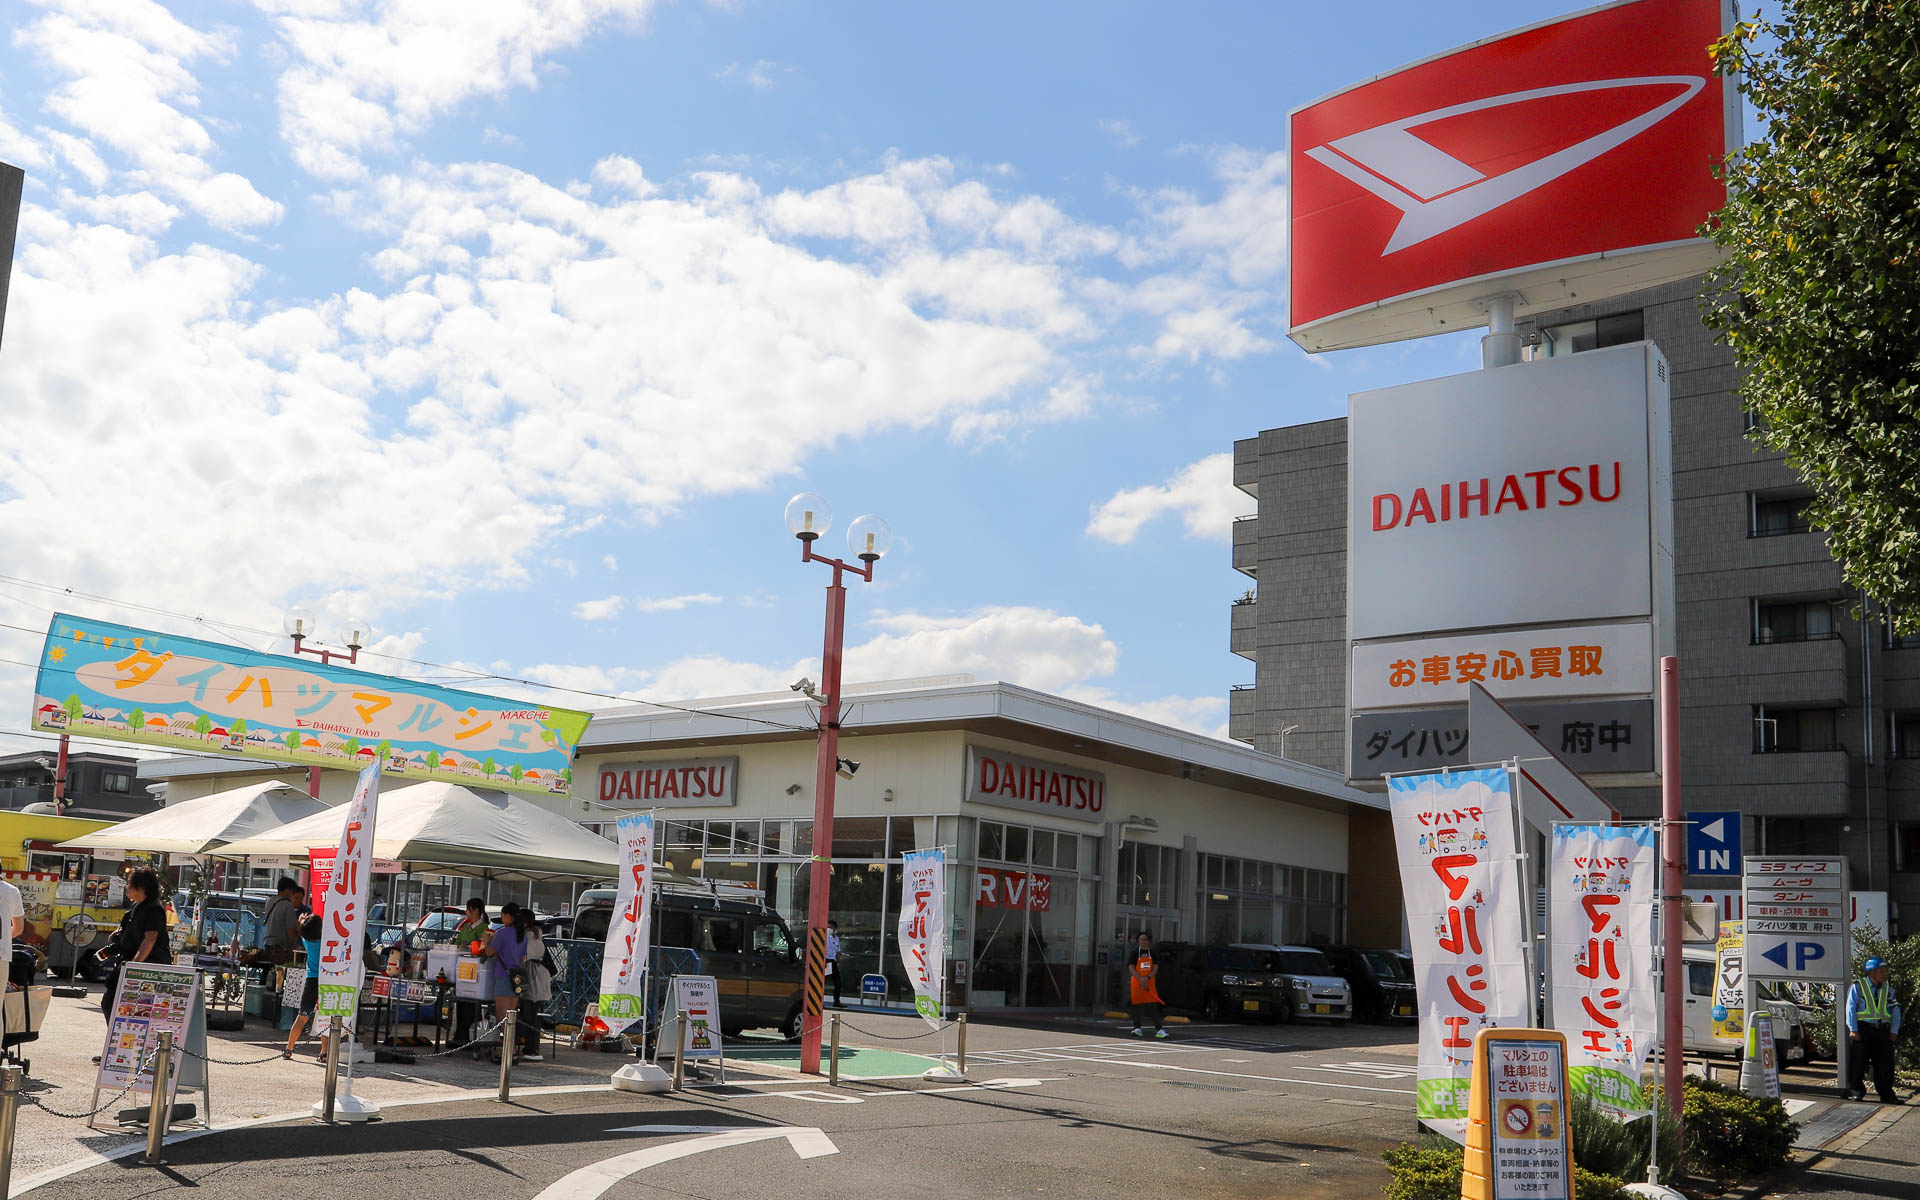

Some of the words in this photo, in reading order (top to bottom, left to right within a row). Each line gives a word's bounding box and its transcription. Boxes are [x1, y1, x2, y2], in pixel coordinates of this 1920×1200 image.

[1372, 461, 1621, 532] DAIHATSU
[1389, 645, 1603, 688] お車安心買取
[113, 647, 534, 751] ダイハツマルシェ
[500, 709, 550, 721] MARCHE
[312, 721, 351, 735] DAIHATSU
[355, 728, 381, 738] TOKYO
[1561, 720, 1632, 755] 府中
[600, 766, 726, 801] DAIHATSU
[980, 756, 1103, 813] DAIHATSU
[1699, 849, 1730, 870] IN
[1772, 877, 1813, 887] ムーヴ
[1773, 892, 1813, 902] タント
[1759, 907, 1829, 916] 車検・点検・整備
[1756, 922, 1808, 931] ダイハツ東京
[1813, 922, 1833, 932] 府中
[1795, 942, 1826, 971] P
[1502, 1050, 1549, 1062] マルシェの
[1503, 1064, 1549, 1078] 駐車場は
[1498, 1080, 1556, 1094] ございません
[1514, 1183, 1550, 1192] いただきます
